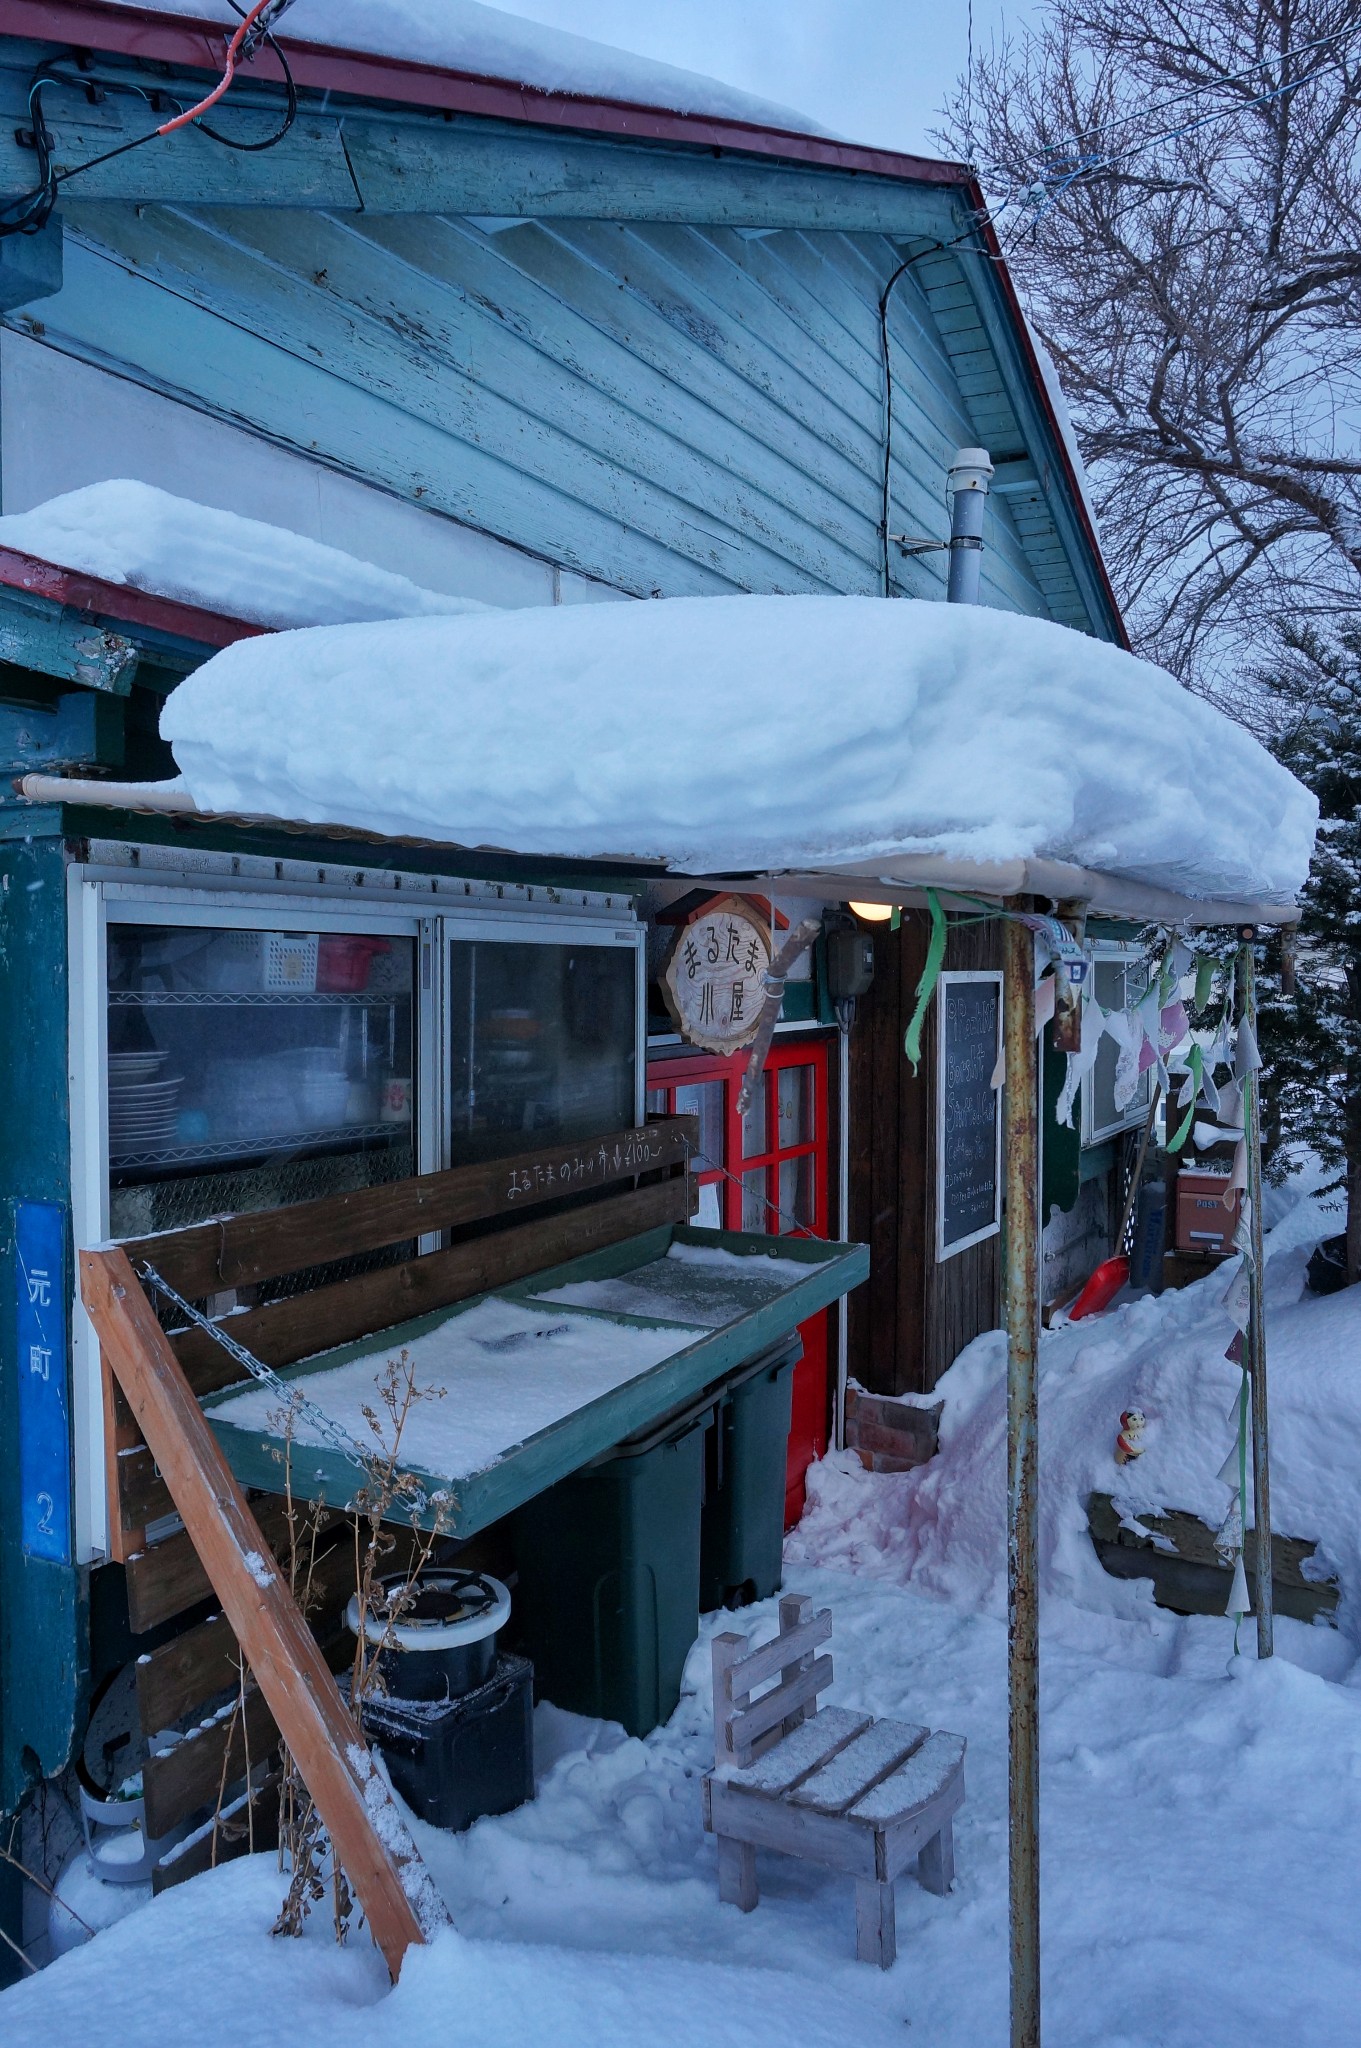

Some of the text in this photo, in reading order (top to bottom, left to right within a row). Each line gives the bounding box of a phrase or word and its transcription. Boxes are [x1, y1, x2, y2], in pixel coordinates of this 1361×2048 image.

[684, 922, 759, 979] まるたま
[699, 981, 744, 1025] 小屋
[1196, 1199, 1219, 1209] POST
[29, 1269, 54, 1535] 元町 2
